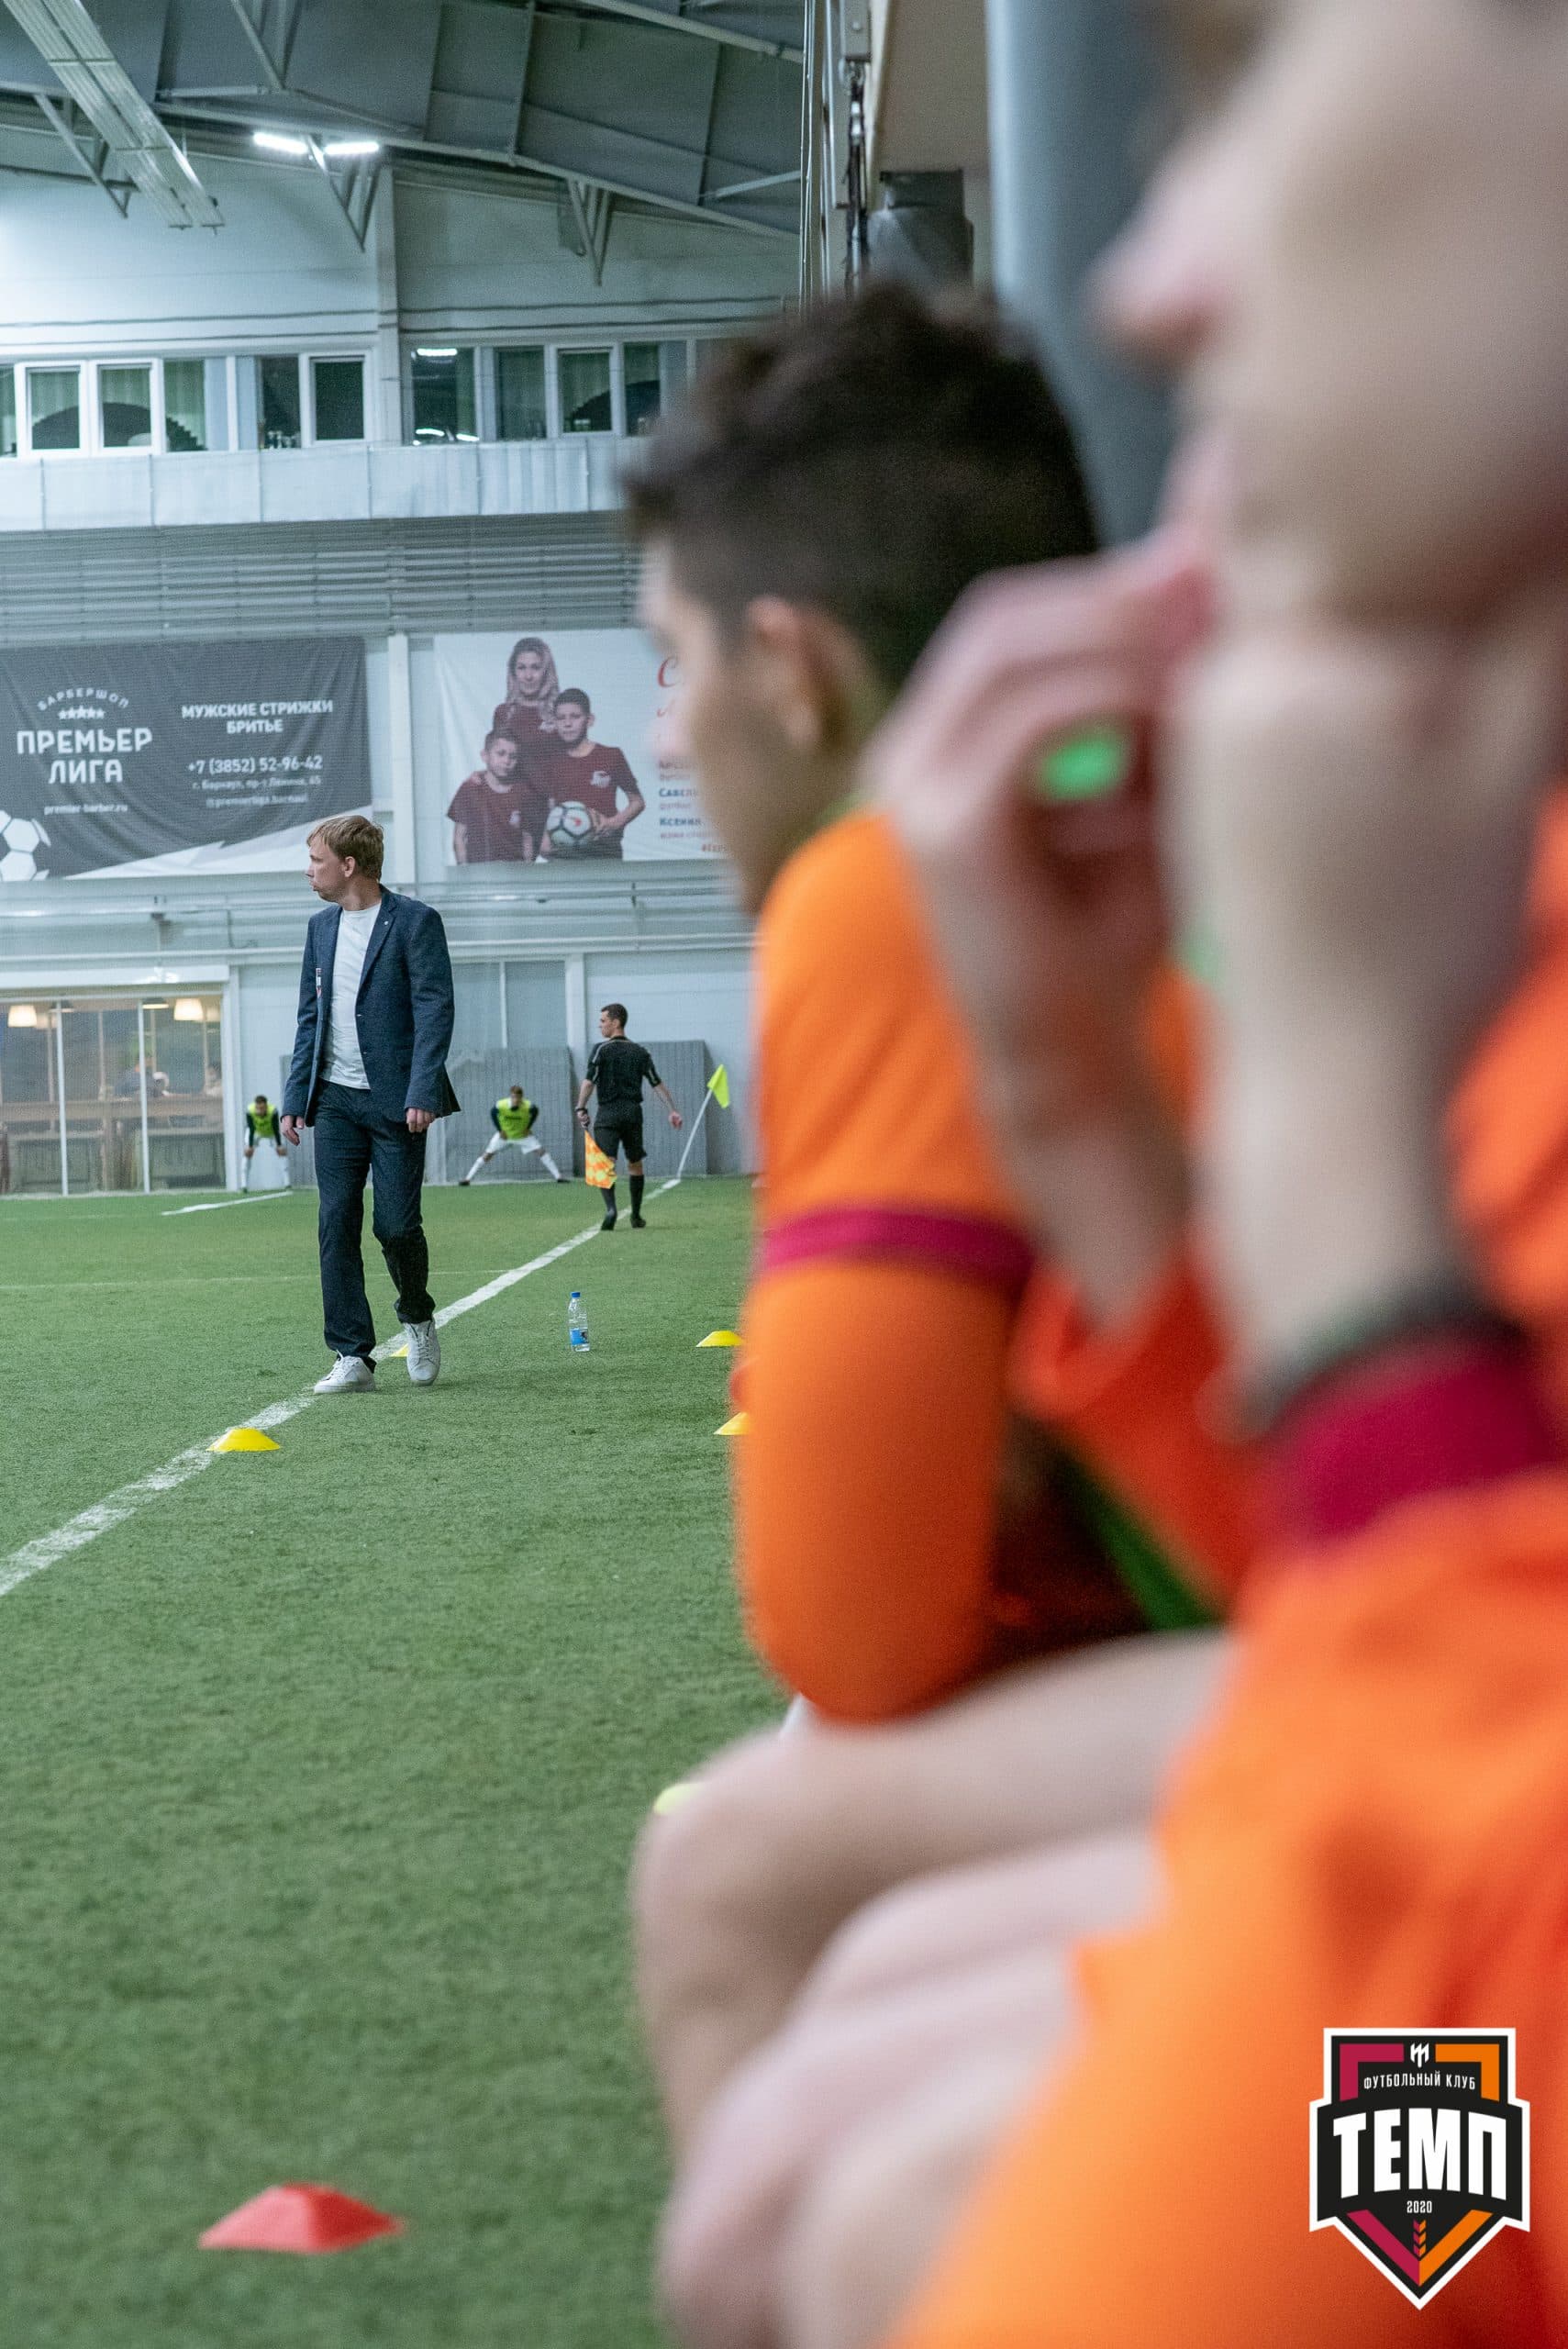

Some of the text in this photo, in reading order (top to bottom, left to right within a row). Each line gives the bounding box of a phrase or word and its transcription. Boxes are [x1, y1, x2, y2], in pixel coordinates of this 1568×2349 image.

[37, 688, 129, 711] БАРБЕРШОП
[182, 700, 333, 718] МУЖСКИЕ СТРИЖКИ
[227, 719, 284, 734] БРИТЬЕ
[17, 728, 153, 754] ПРЕМЬЕР
[48, 759, 123, 785] ЛИГА
[188, 754, 323, 775] +7 (3852) 52-96-42
